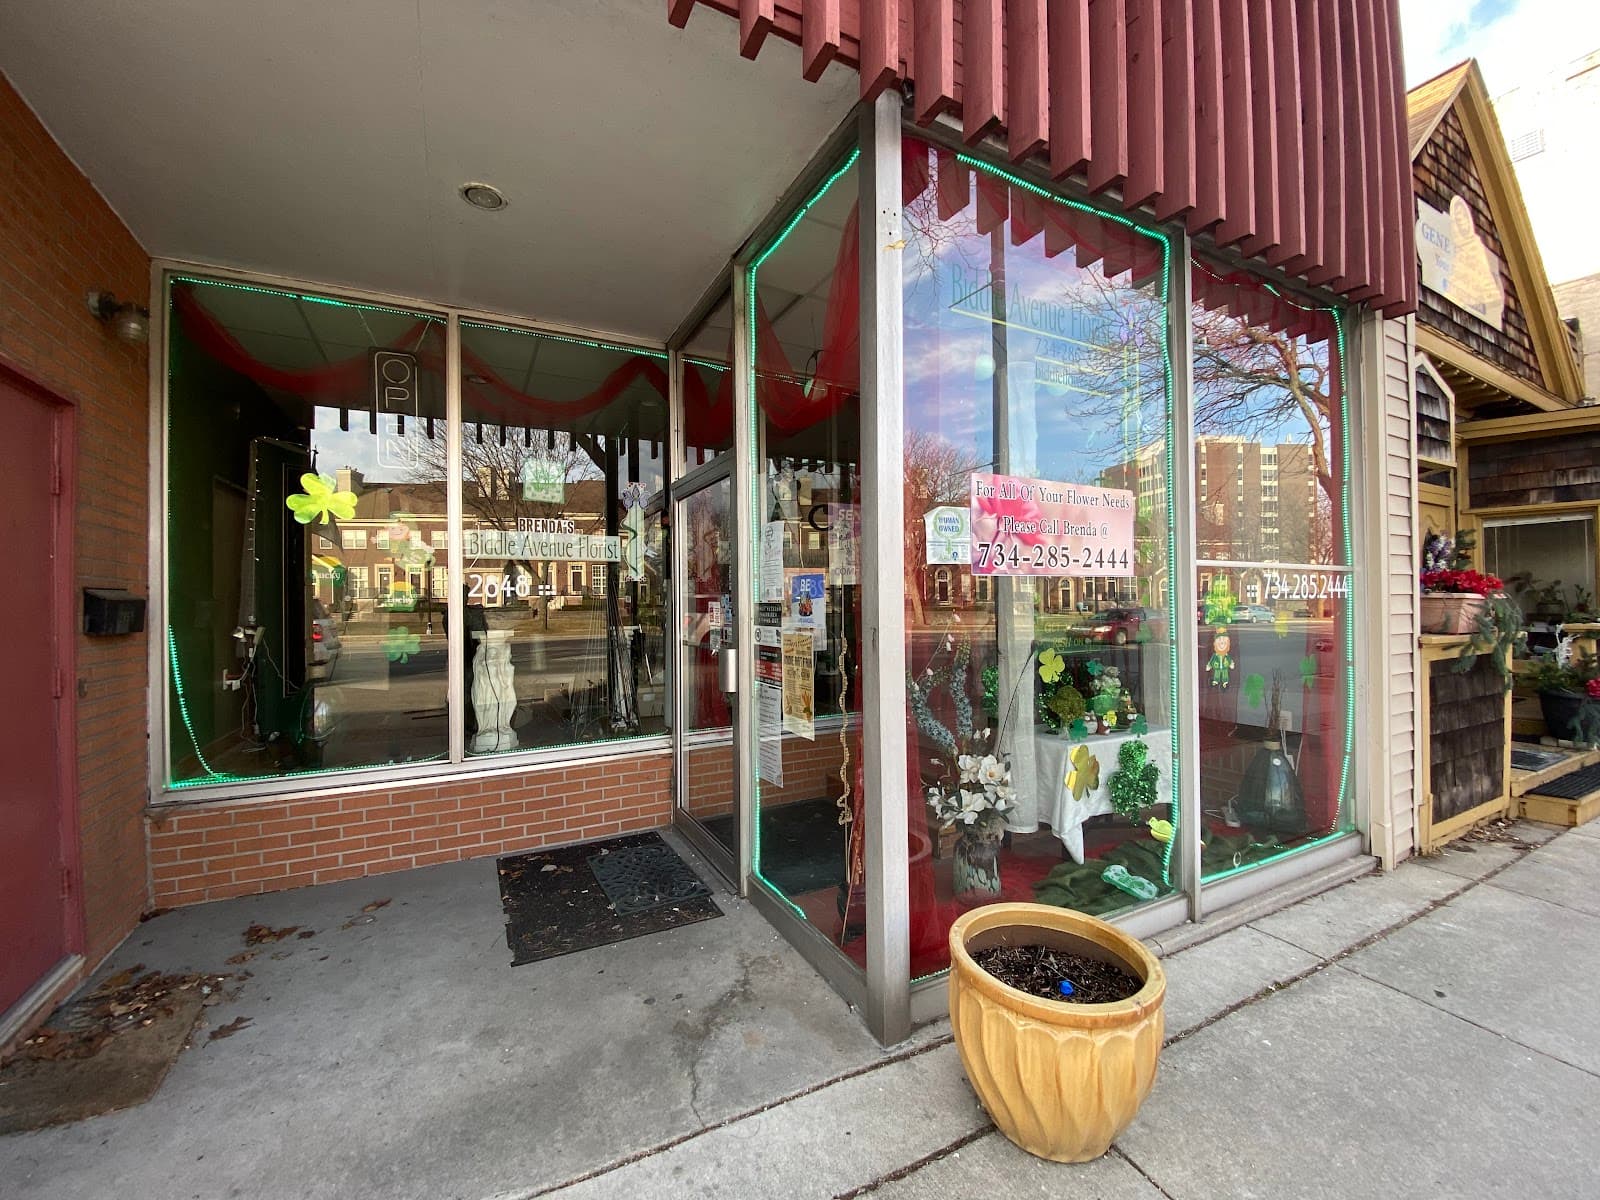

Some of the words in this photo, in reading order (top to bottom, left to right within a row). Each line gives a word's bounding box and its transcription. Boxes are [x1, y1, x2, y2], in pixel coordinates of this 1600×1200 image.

[952, 263, 1005, 317] Bidde
[1009, 284, 1066, 334] Avenue
[382, 359, 411, 461] OPEN
[976, 480, 995, 496] For
[999, 481, 1016, 498] All
[1020, 483, 1034, 501] Of
[1039, 486, 1064, 504] Your
[1067, 489, 1099, 507] Flower
[1102, 493, 1130, 509] Needs
[519, 518, 574, 534] BRENDA'S
[1003, 516, 1036, 534] Please
[1039, 519, 1059, 535] Call
[1063, 521, 1097, 536] Brenda
[469, 532, 516, 557] Biddle
[521, 535, 573, 558] Avenue
[578, 535, 618, 559] Florist
[978, 542, 1129, 569] 734-285-2444
[1263, 574, 1348, 599] 734.285.2444
